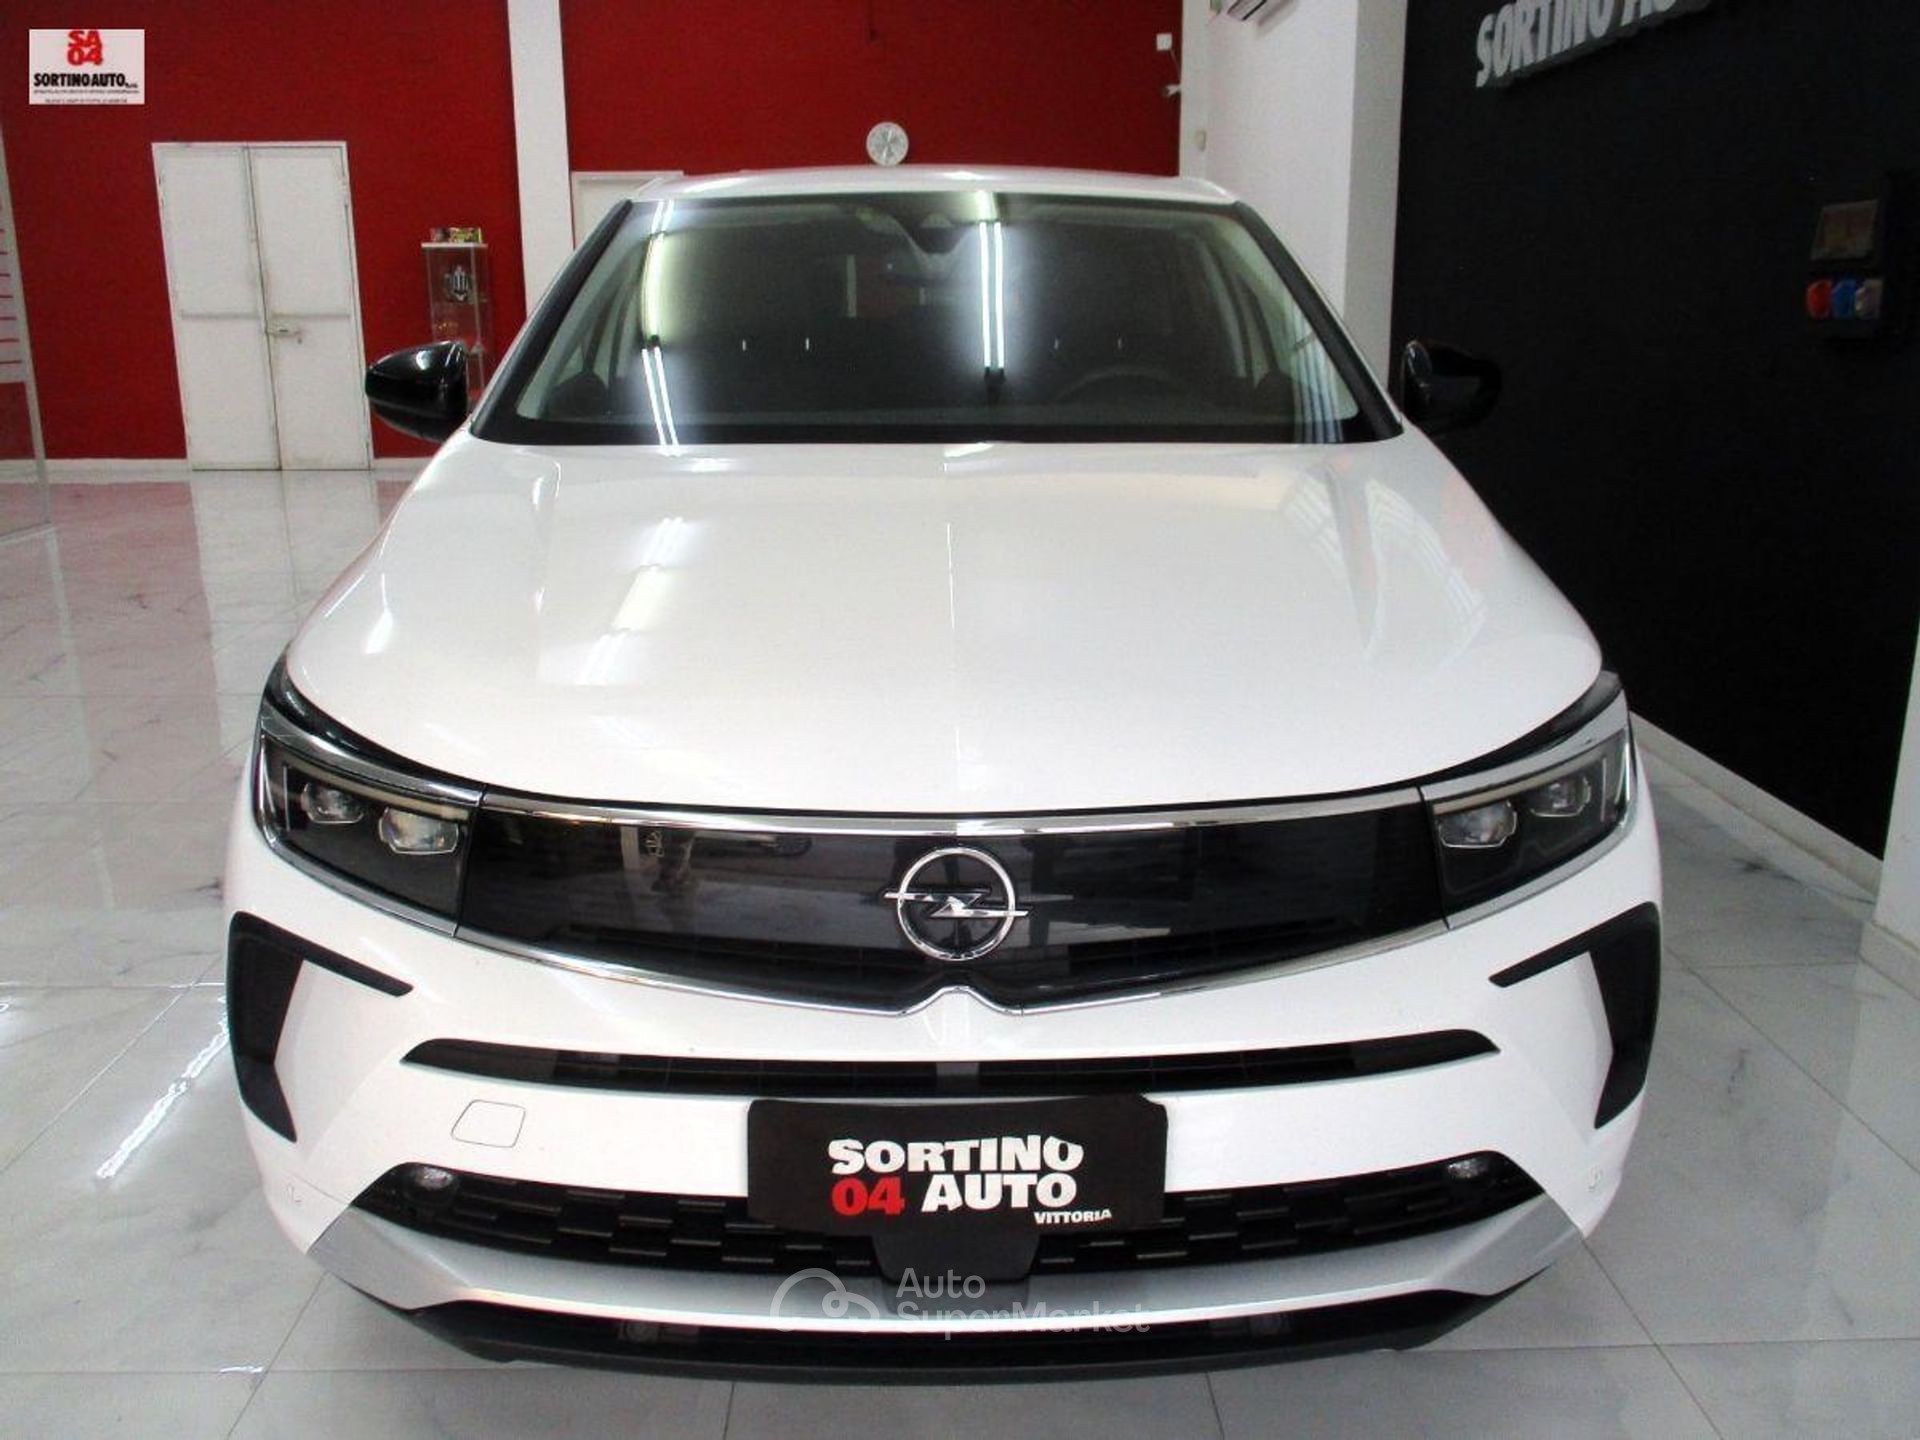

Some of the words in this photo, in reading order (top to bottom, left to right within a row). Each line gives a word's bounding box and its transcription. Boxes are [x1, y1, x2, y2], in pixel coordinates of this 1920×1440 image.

[828, 1135, 1084, 1175] SORTINO
[831, 1176, 905, 1216] 04
[921, 1172, 1077, 1213] AUTO
[1034, 1209, 1112, 1225] VITTORIA
